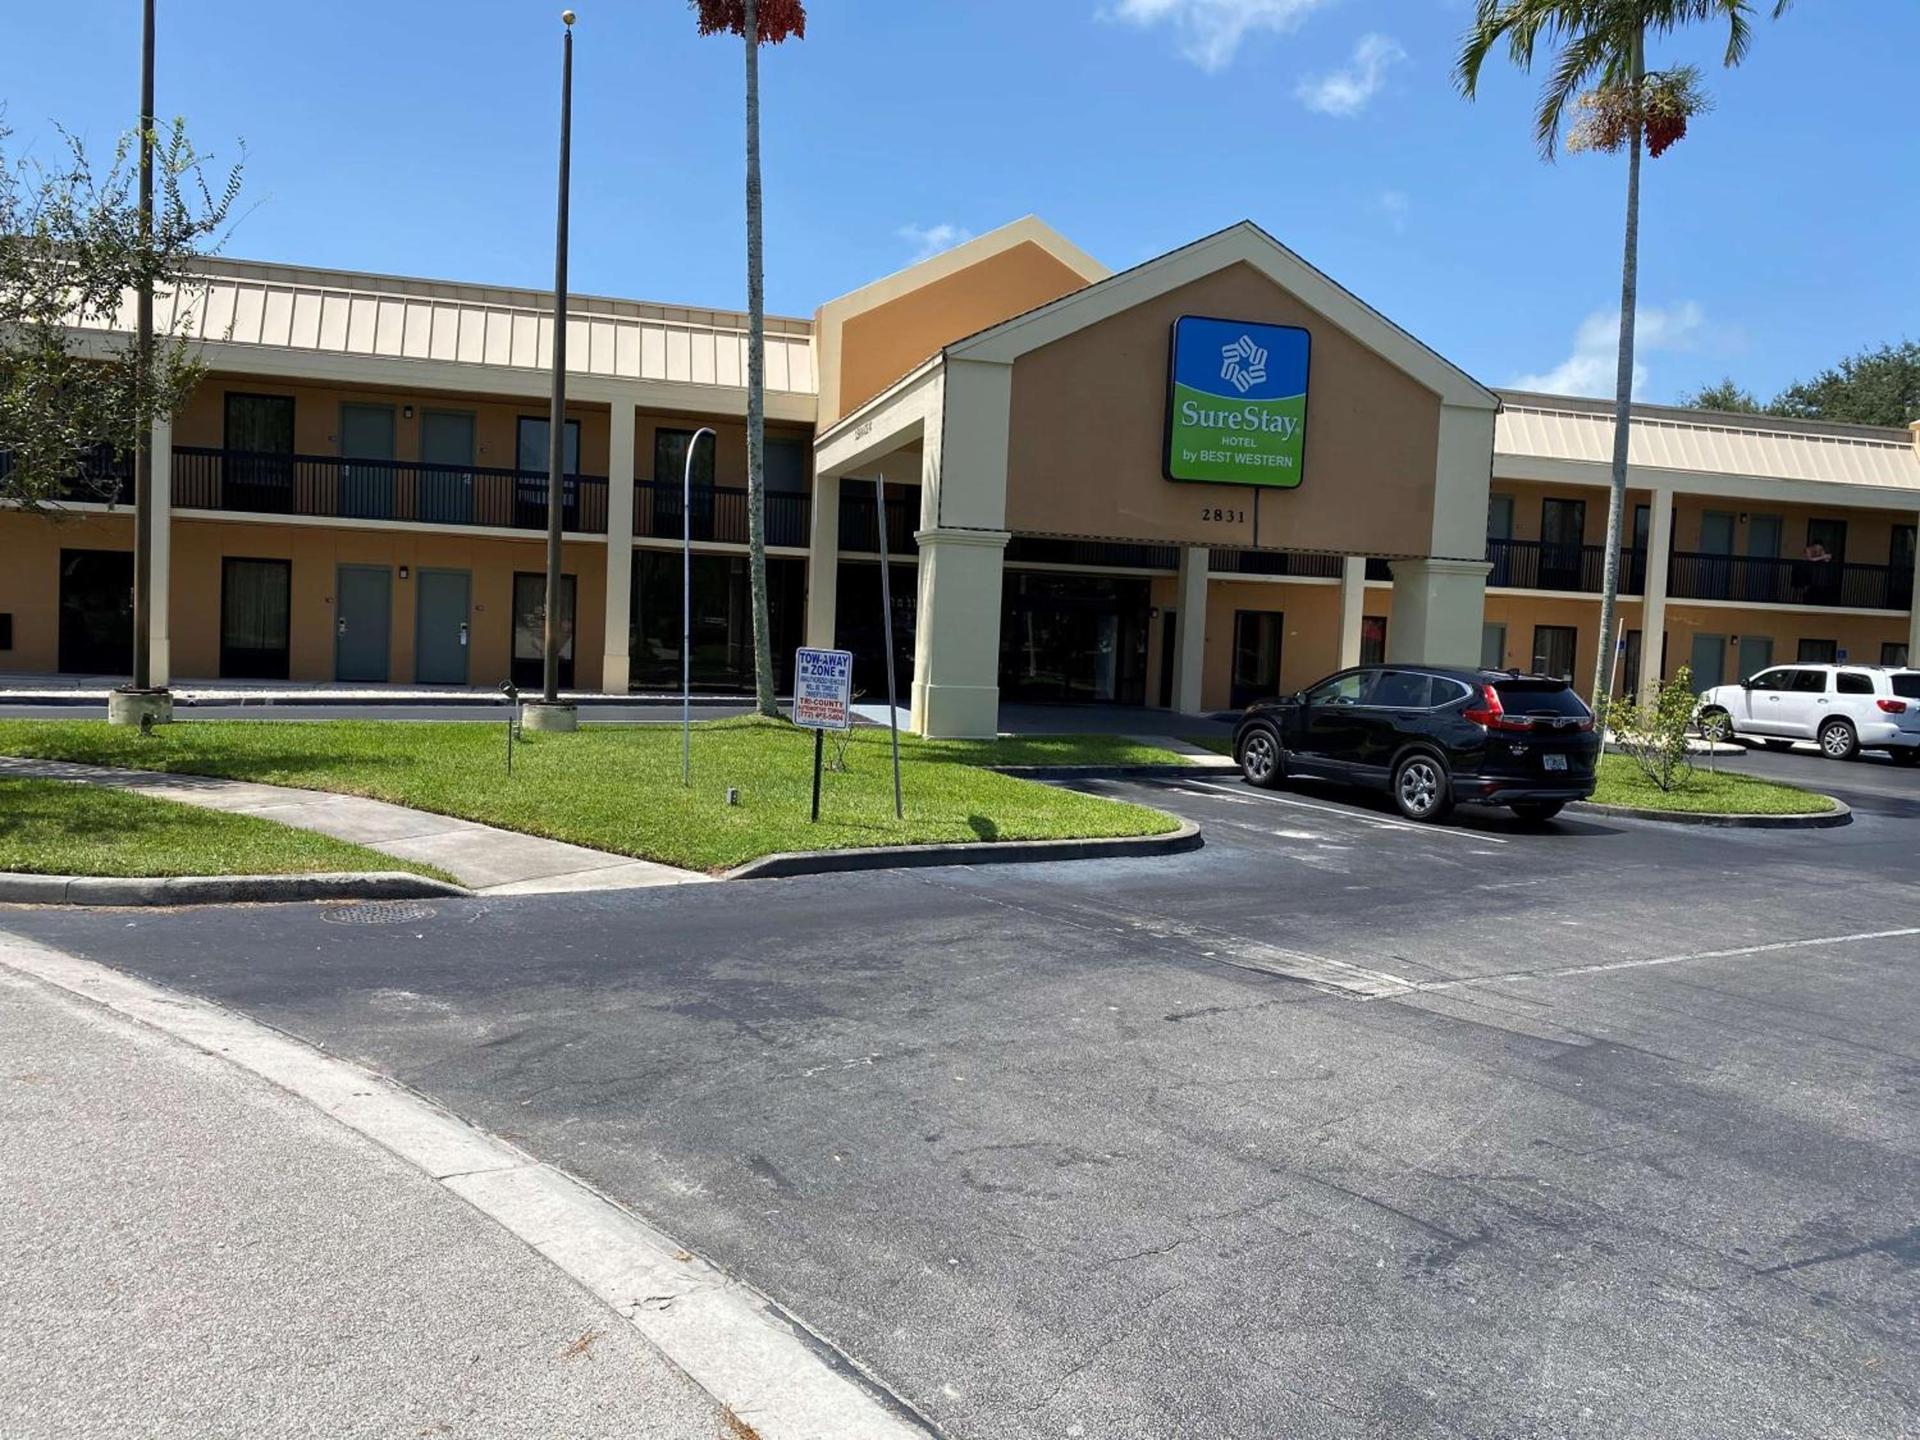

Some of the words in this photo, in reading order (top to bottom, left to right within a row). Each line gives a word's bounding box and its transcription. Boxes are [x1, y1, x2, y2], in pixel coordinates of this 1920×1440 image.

[1182, 401, 1298, 440] SureStay
[1221, 437, 1257, 448] HOTEL
[1183, 449, 1197, 463] by
[1200, 450, 1231, 463] BEST
[1234, 453, 1293, 467] WESTERN
[1202, 508, 1244, 523] 2831
[800, 652, 848, 667] TOW-AWAY
[811, 664, 836, 677] ZONE
[800, 697, 844, 708] TRI-COUNTY
